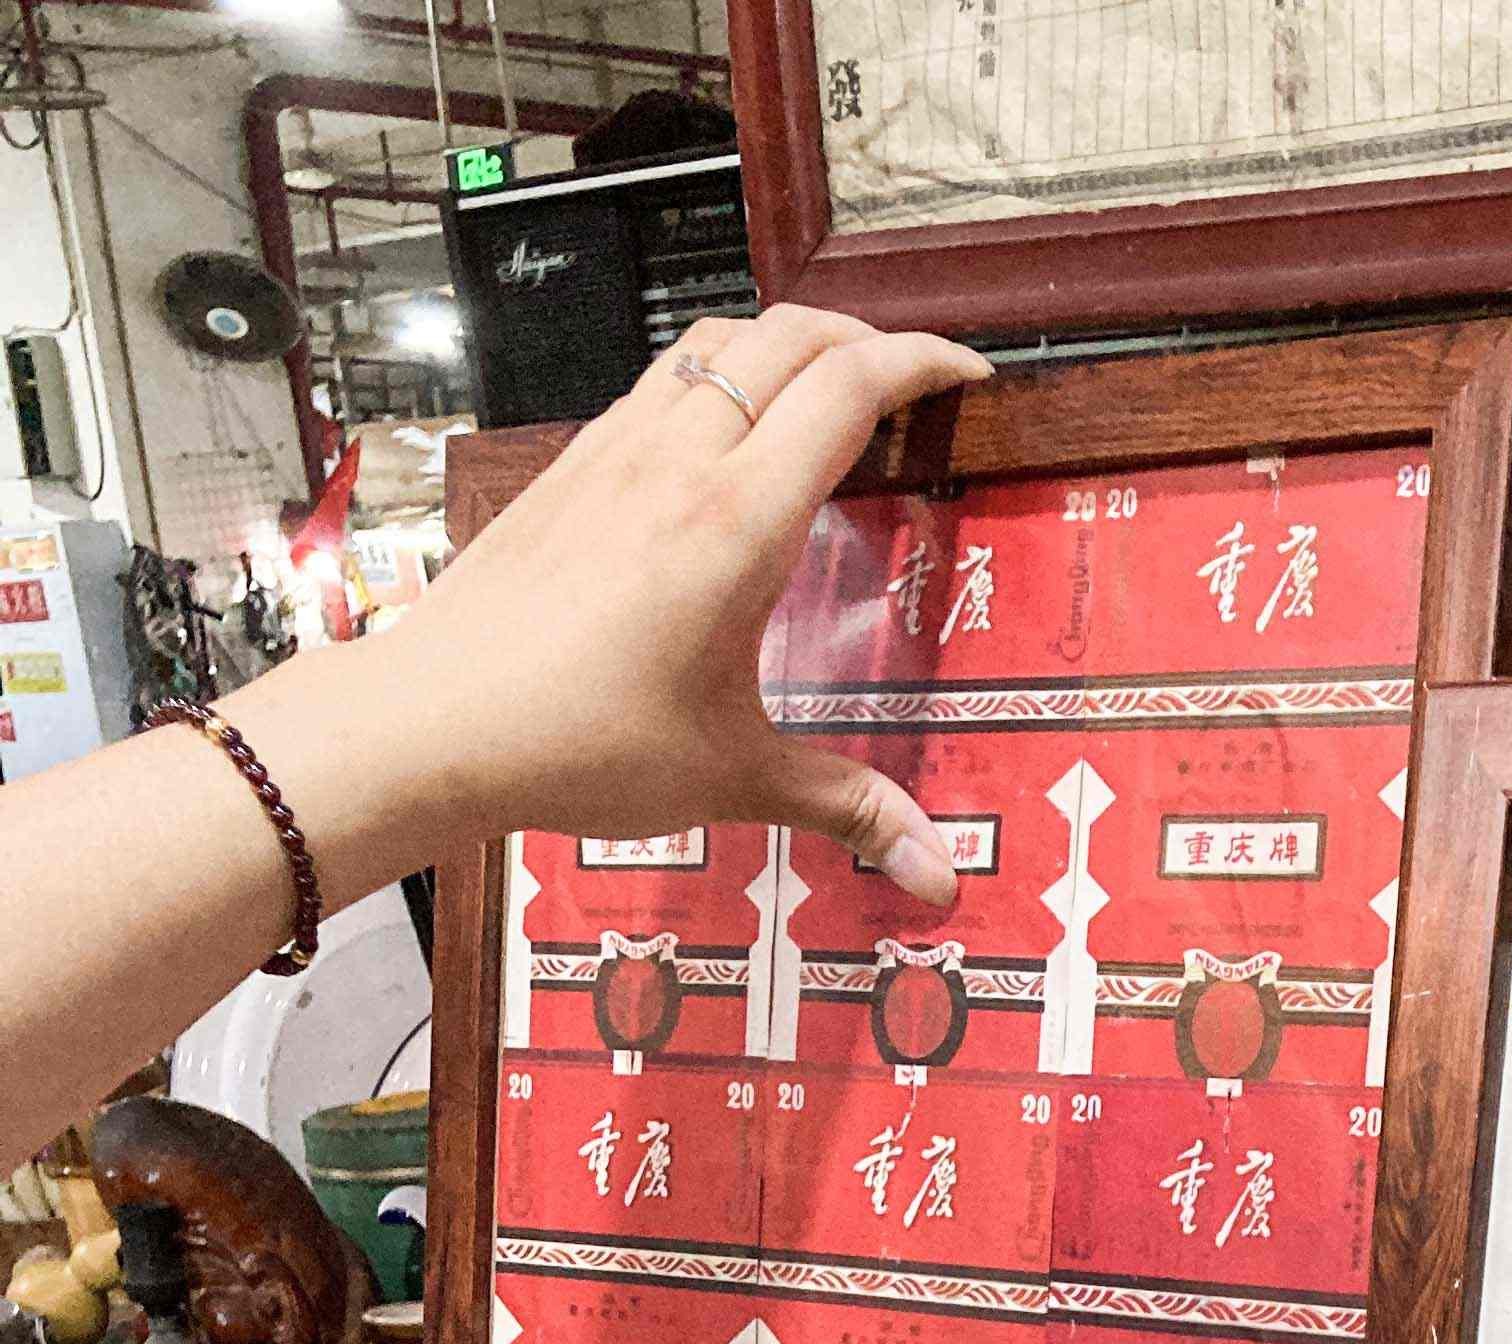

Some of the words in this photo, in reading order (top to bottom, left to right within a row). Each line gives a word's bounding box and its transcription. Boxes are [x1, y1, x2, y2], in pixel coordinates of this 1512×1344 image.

[1396, 464, 1430, 497] 20
[1063, 491, 1096, 521] 20
[1105, 488, 1137, 519] 20
[1184, 831, 1299, 865] 重庆牌
[509, 1073, 533, 1100] 20
[778, 1084, 804, 1110] 20
[1072, 1093, 1101, 1124] 20
[1349, 1106, 1381, 1136] 20
